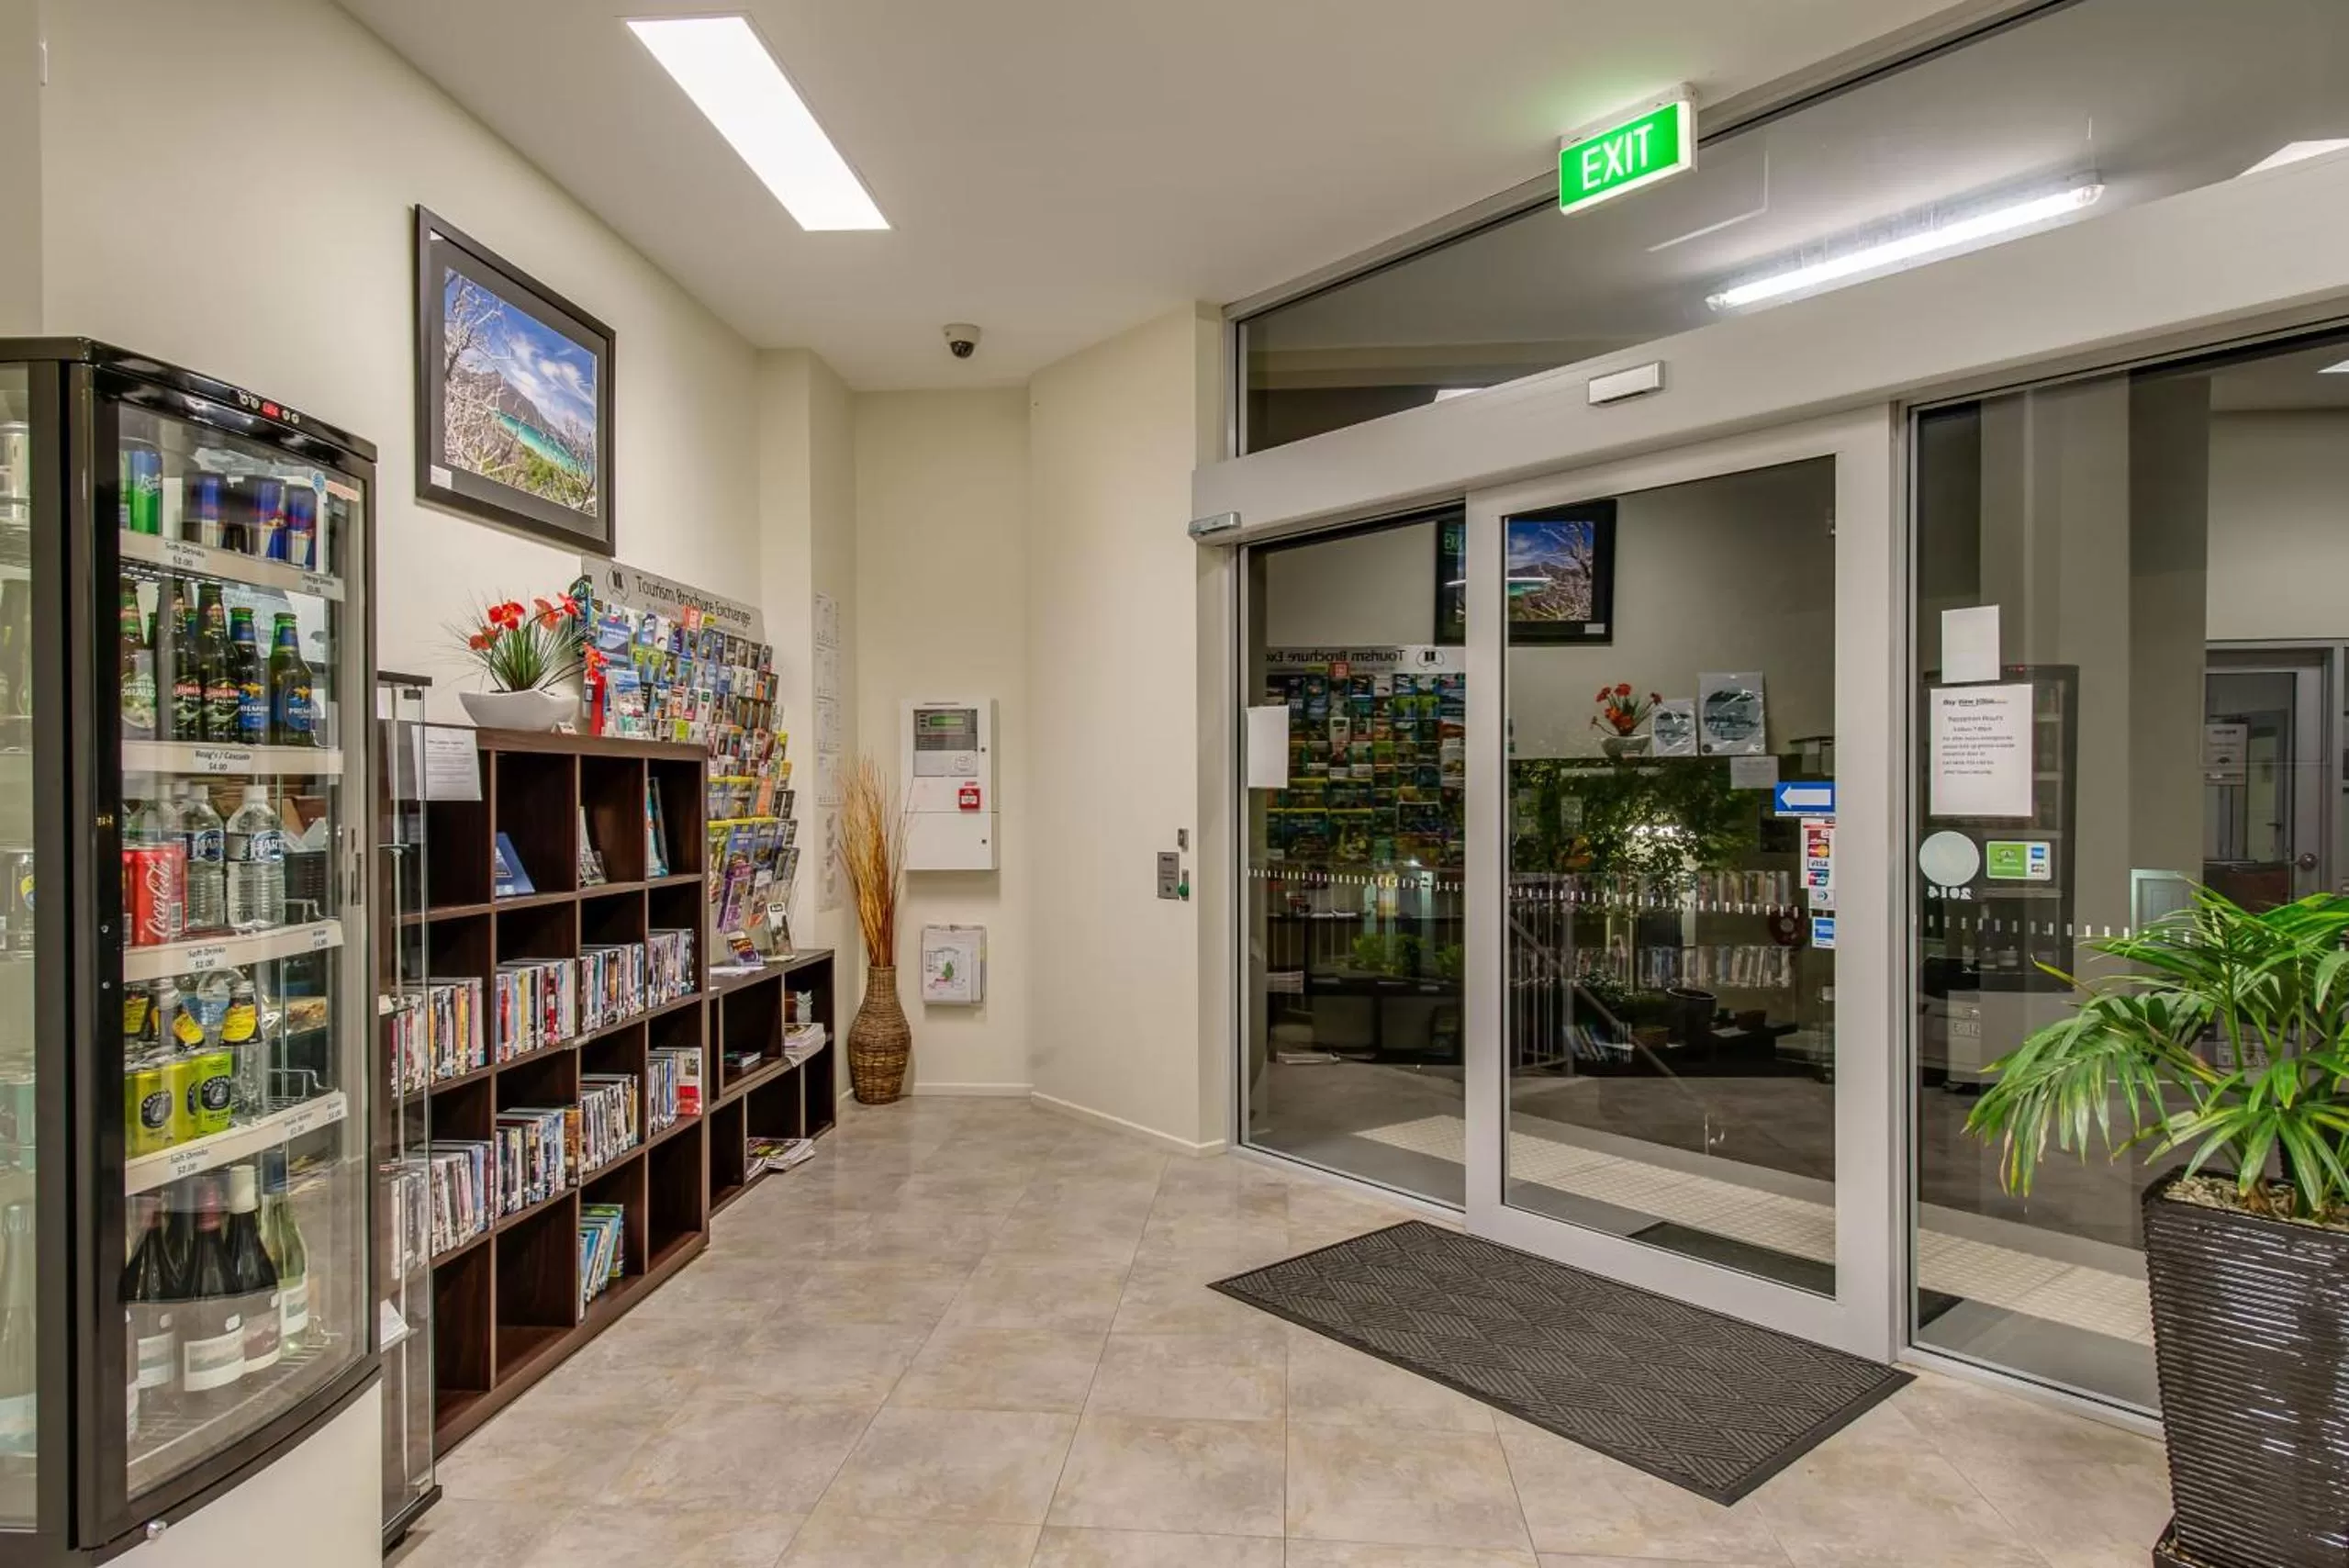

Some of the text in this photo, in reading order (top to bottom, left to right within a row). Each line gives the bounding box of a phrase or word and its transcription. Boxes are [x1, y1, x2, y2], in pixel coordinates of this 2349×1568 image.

[1581, 123, 1653, 192] EXIT
[635, 575, 676, 602] Tourism
[676, 588, 714, 615] Brochure
[714, 600, 752, 628] Exchange
